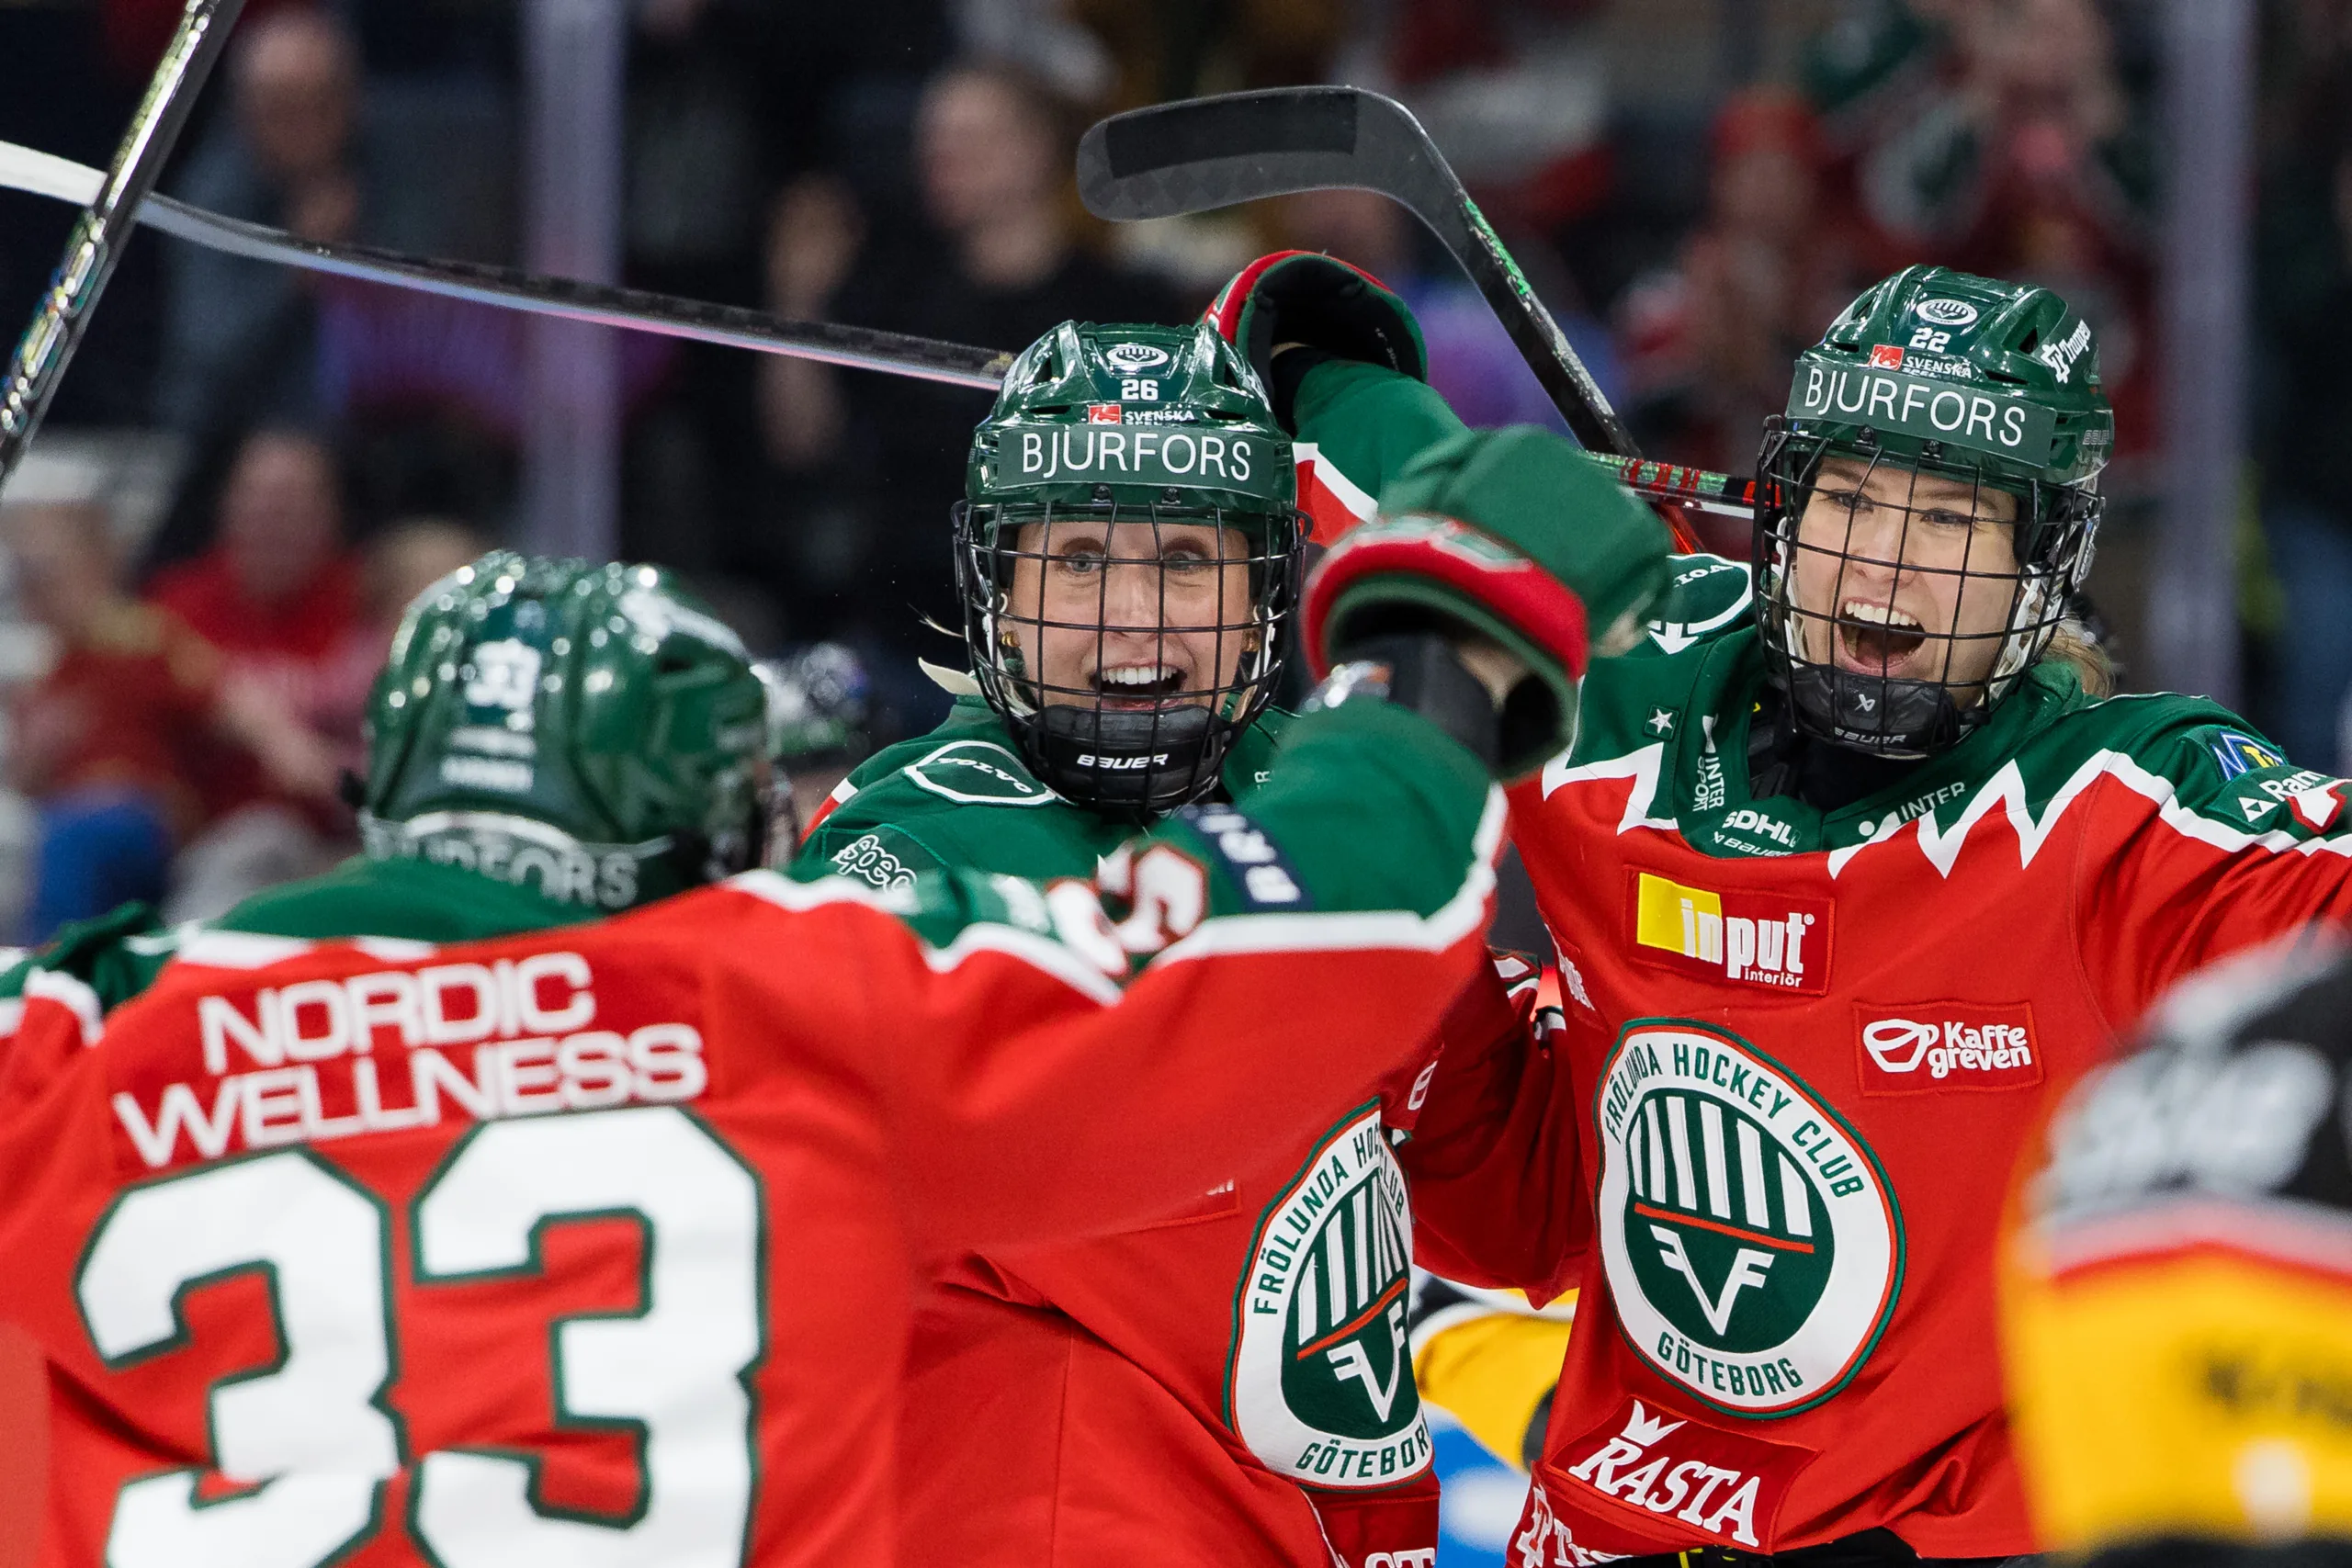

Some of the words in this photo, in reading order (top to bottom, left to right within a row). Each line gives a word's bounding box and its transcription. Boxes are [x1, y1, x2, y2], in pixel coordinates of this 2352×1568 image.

[1909, 325, 1951, 354] 22
[1905, 355, 1973, 378] SVENSKA
[1121, 378, 1159, 400] 26
[1804, 368, 2026, 446] BJURFORS
[1125, 410, 1195, 422] SVENSKA
[1023, 432, 1251, 481] BJURFORS
[937, 757, 1033, 794] VOLVO
[1077, 753, 1169, 769] BAUER
[1704, 756, 1724, 809] INTER
[1722, 810, 1799, 848] SDHL
[1744, 966, 1804, 988] interiör
[198, 951, 596, 1075] NORDIC
[1943, 1021, 2028, 1051] Kaffe
[1927, 1045, 2032, 1079] greven
[111, 1022, 707, 1168] WELLNESS
[1605, 1043, 1663, 1145] FRÖLUNDA
[1673, 1043, 1792, 1120] HOCKEY
[1792, 1120, 1865, 1199] CLUB
[1253, 1155, 1350, 1314] FRÖLUNDA
[74, 1104, 769, 1568] 33
[1657, 1331, 1804, 1397] GÖTEBORG
[1567, 1437, 1760, 1548] RASTA
